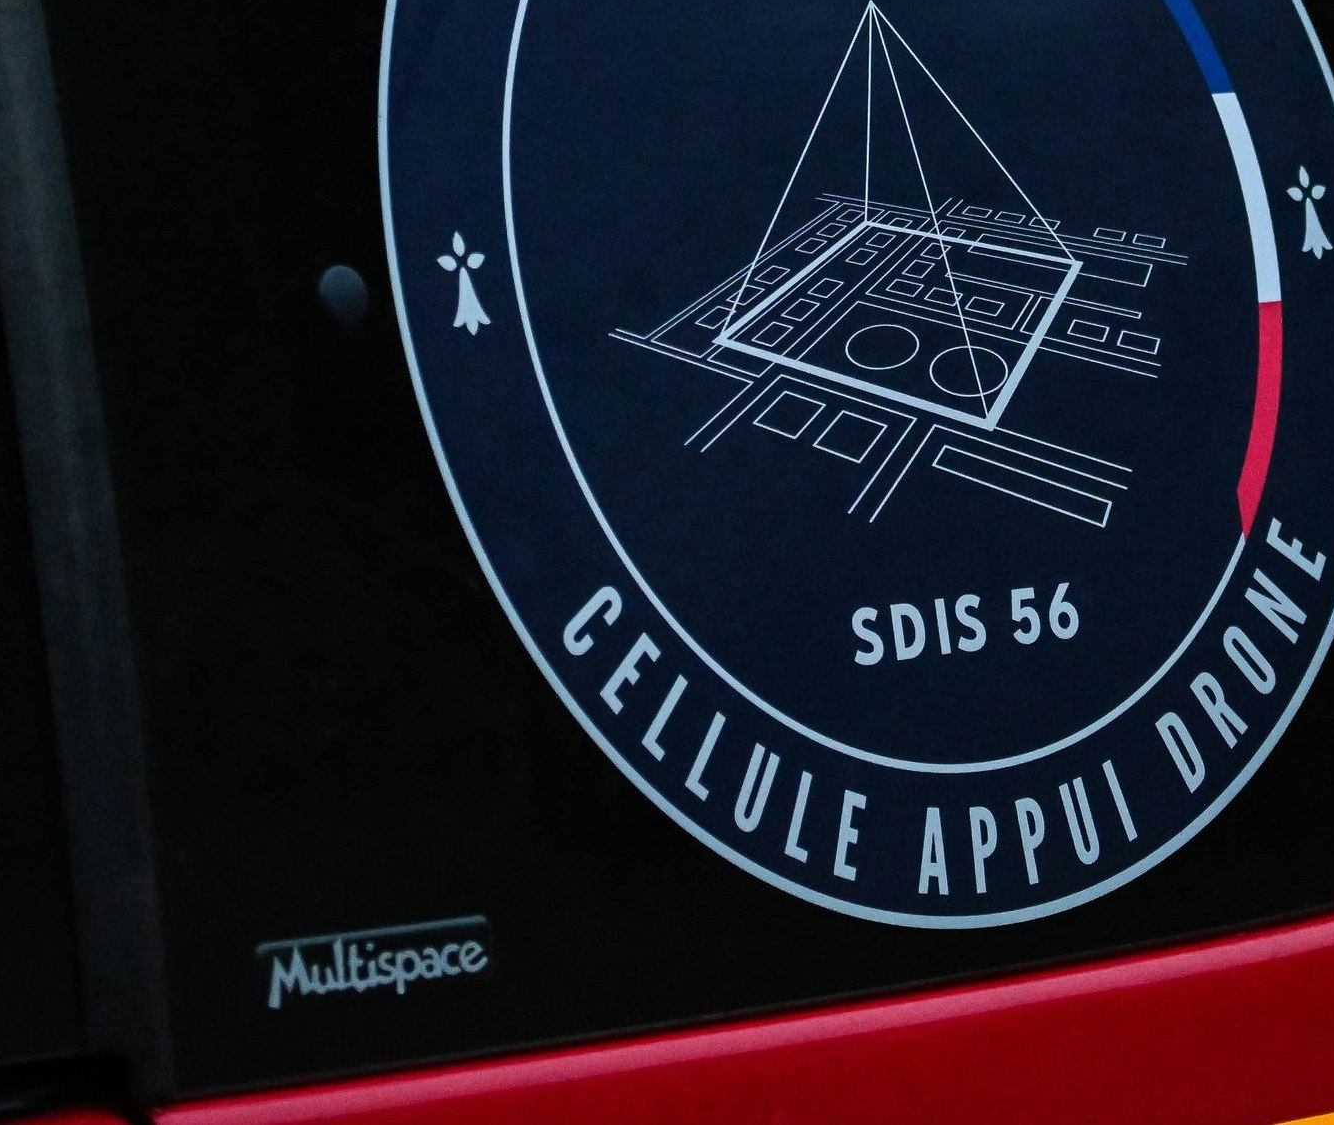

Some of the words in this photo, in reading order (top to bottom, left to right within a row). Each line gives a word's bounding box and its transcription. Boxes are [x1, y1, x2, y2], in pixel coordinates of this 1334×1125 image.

[851, 598, 987, 666] SDIS
[1011, 582, 1079, 645] 56
[563, 586, 867, 881] CELLULE
[918, 759, 1138, 895] APPUI
[1154, 517, 1327, 794] DRONE
[267, 937, 489, 1010] Multispace
